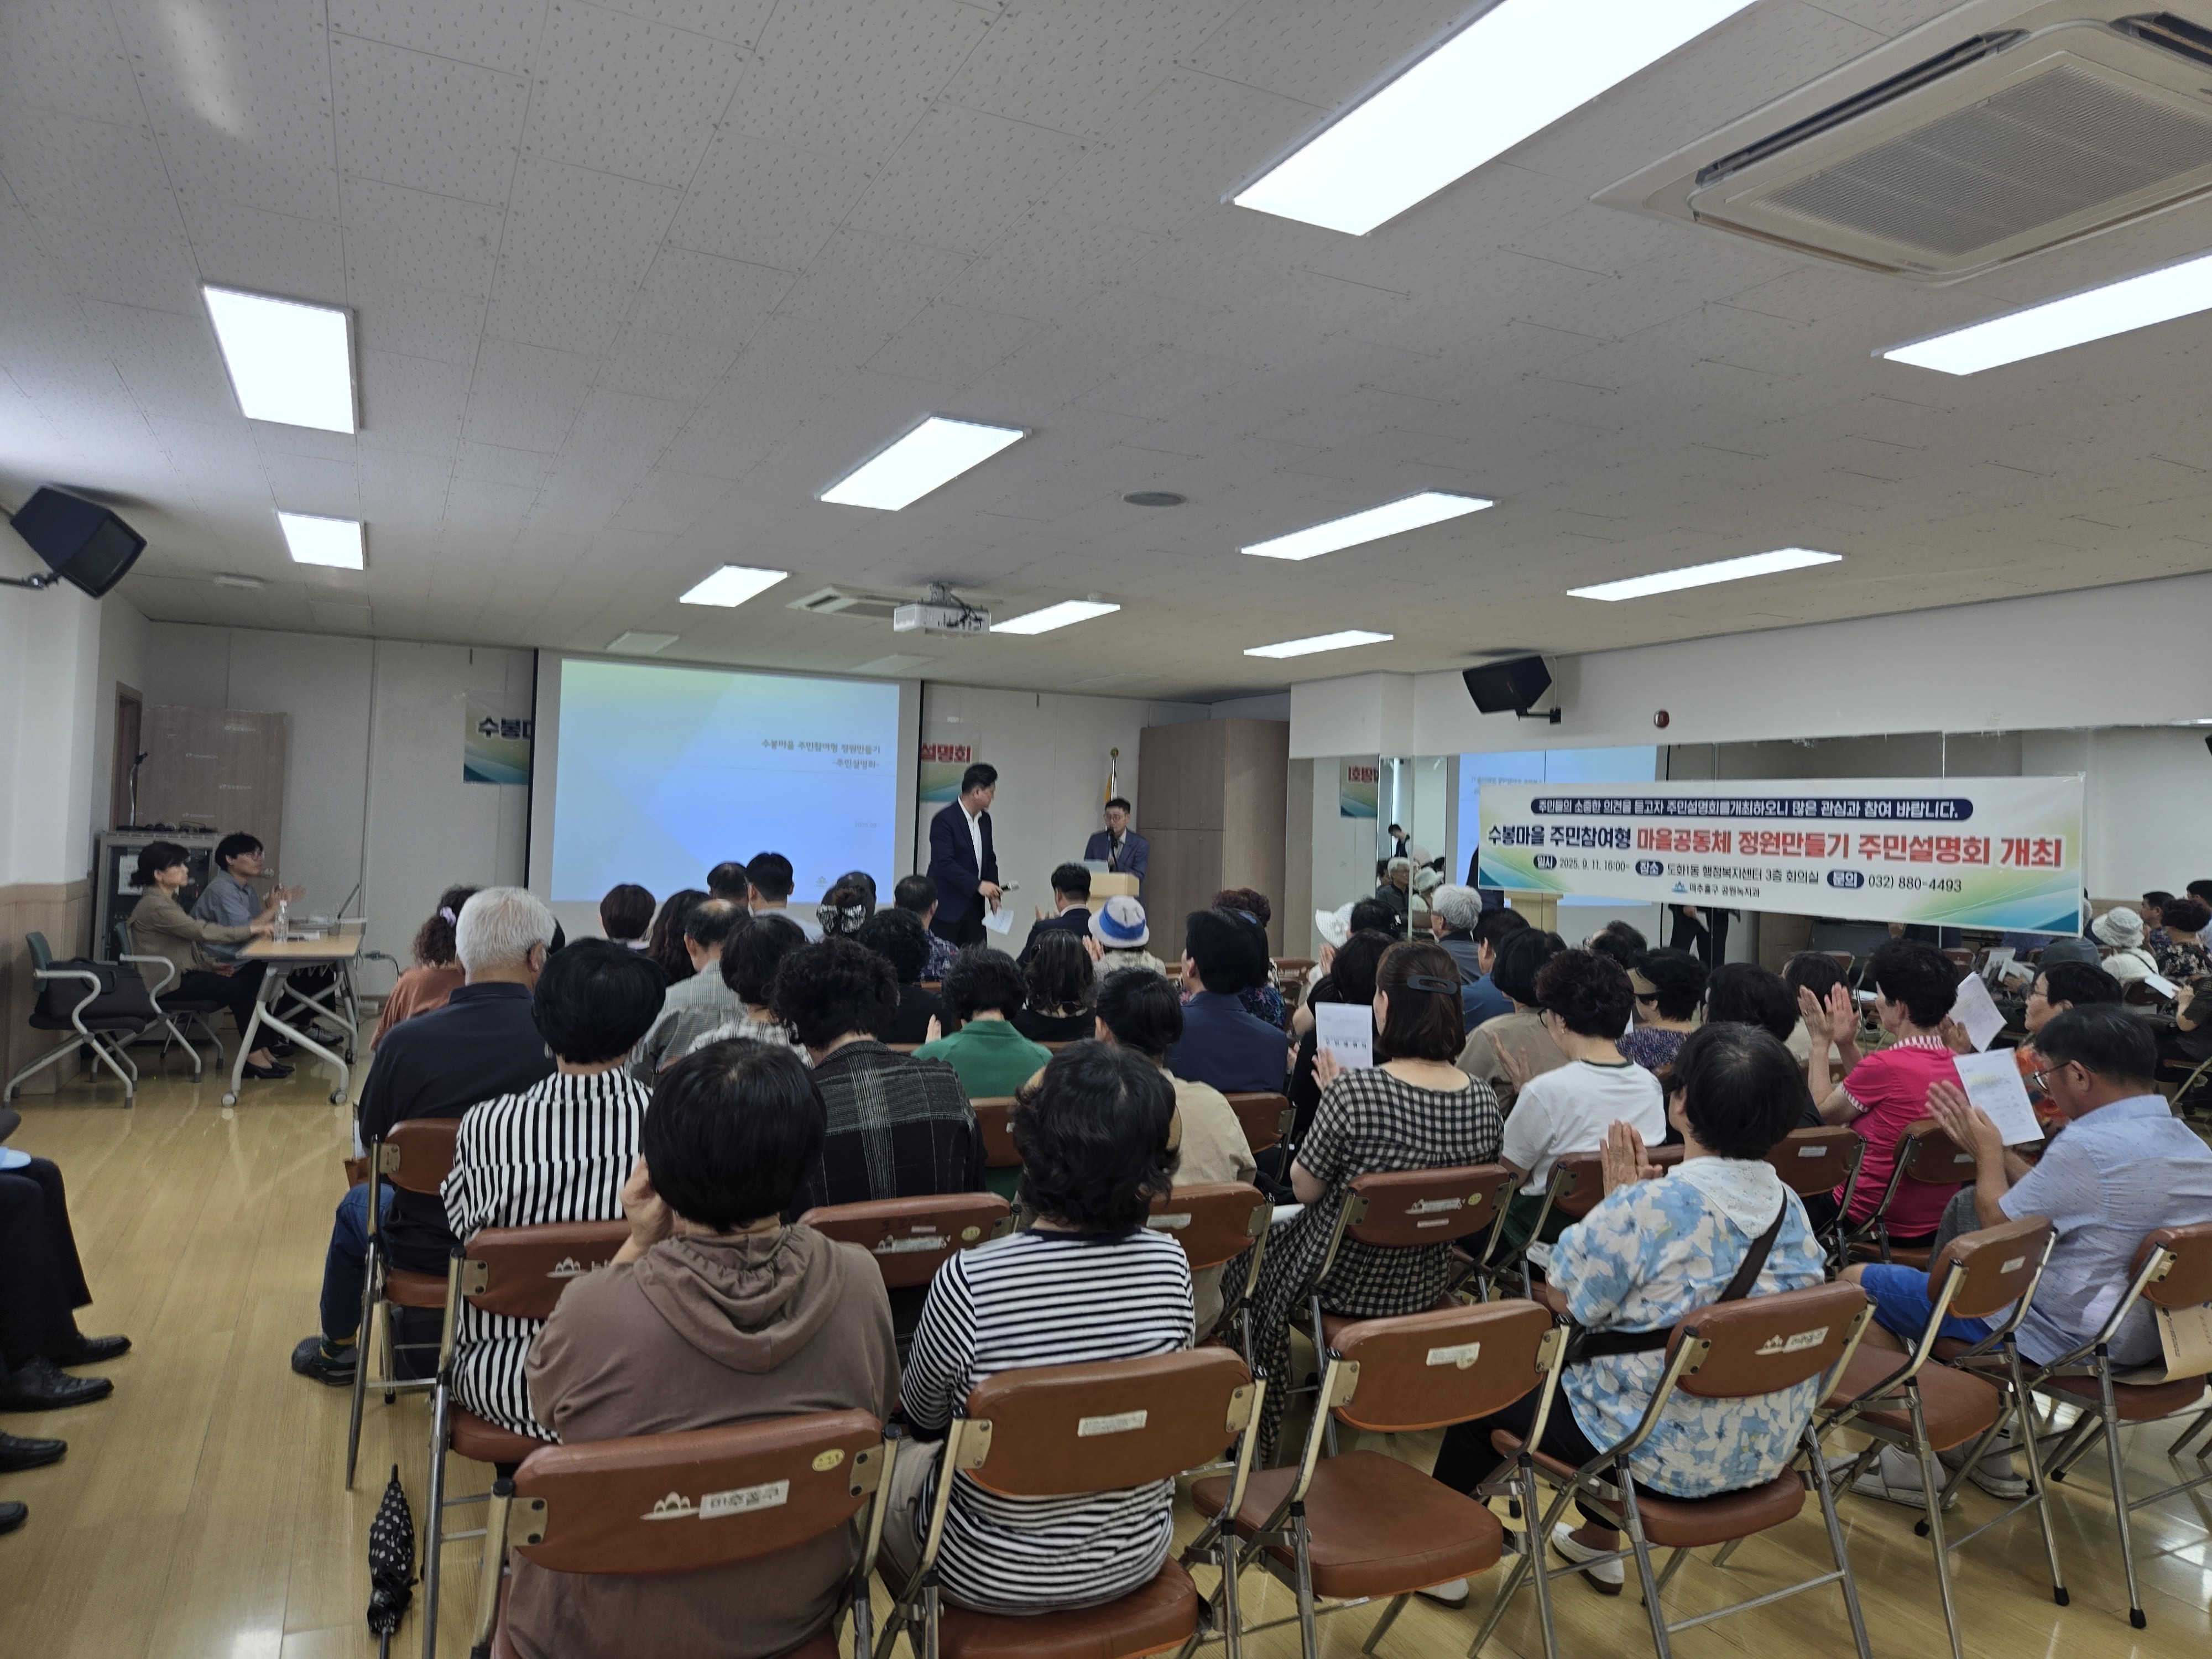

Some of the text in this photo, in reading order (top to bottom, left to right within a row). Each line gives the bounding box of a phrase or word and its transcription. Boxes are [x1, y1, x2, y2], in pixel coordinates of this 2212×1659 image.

[1539, 799, 1572, 813] 주민들의
[1574, 799, 1601, 814] 소중한
[1604, 799, 1631, 815] 의견을
[1635, 800, 1663, 815] 듣고자
[1792, 800, 1817, 817] 많은
[1822, 800, 1860, 818] 관심과
[1865, 800, 1891, 818] 참여
[1897, 800, 1958, 819] 바랍니다.
[1489, 825, 2062, 868] 수봉마을 주민참여형 마을공동체 정원만들기 주민설명회 개최
[1537, 855, 1553, 869] 일시
[1640, 861, 1658, 875] 장소
[1667, 863, 1699, 877] 도화1동
[1703, 864, 1762, 881] 행정복지센터
[1766, 868, 1782, 882] 3층
[1786, 869, 1819, 884] 회의실
[1833, 870, 1857, 888] 문의
[1868, 874, 1894, 890] 032)
[1689, 883, 1718, 895] 미추홀구
